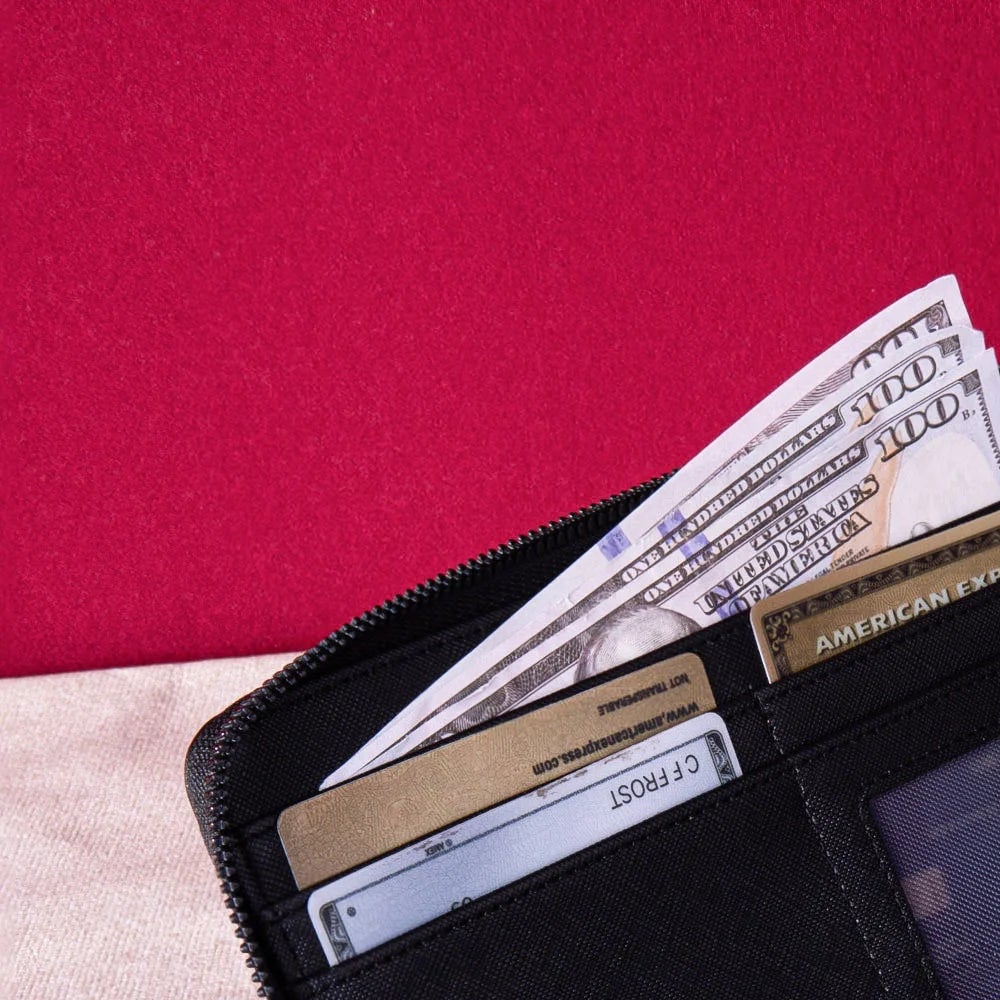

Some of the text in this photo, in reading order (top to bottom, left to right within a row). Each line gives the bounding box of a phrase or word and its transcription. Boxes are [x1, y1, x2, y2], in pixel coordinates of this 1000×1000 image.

[851, 355, 937, 427] 100
[874, 393, 960, 462] 100
[621, 549, 662, 583] ONE
[659, 478, 750, 554] HUNDRED
[748, 414, 838, 483] DOLLARS
[643, 570, 684, 603] ONE
[682, 502, 777, 577] HUNDRED
[775, 446, 862, 509] DOLLARS
[751, 504, 809, 550] THE
[694, 535, 790, 616] UNITED
[786, 474, 880, 550] STATES
[762, 511, 872, 598] AMERICA
[816, 588, 950, 656] AMERICAN
[669, 671, 692, 689] NOT
[610, 754, 699, 810] C F FROST
